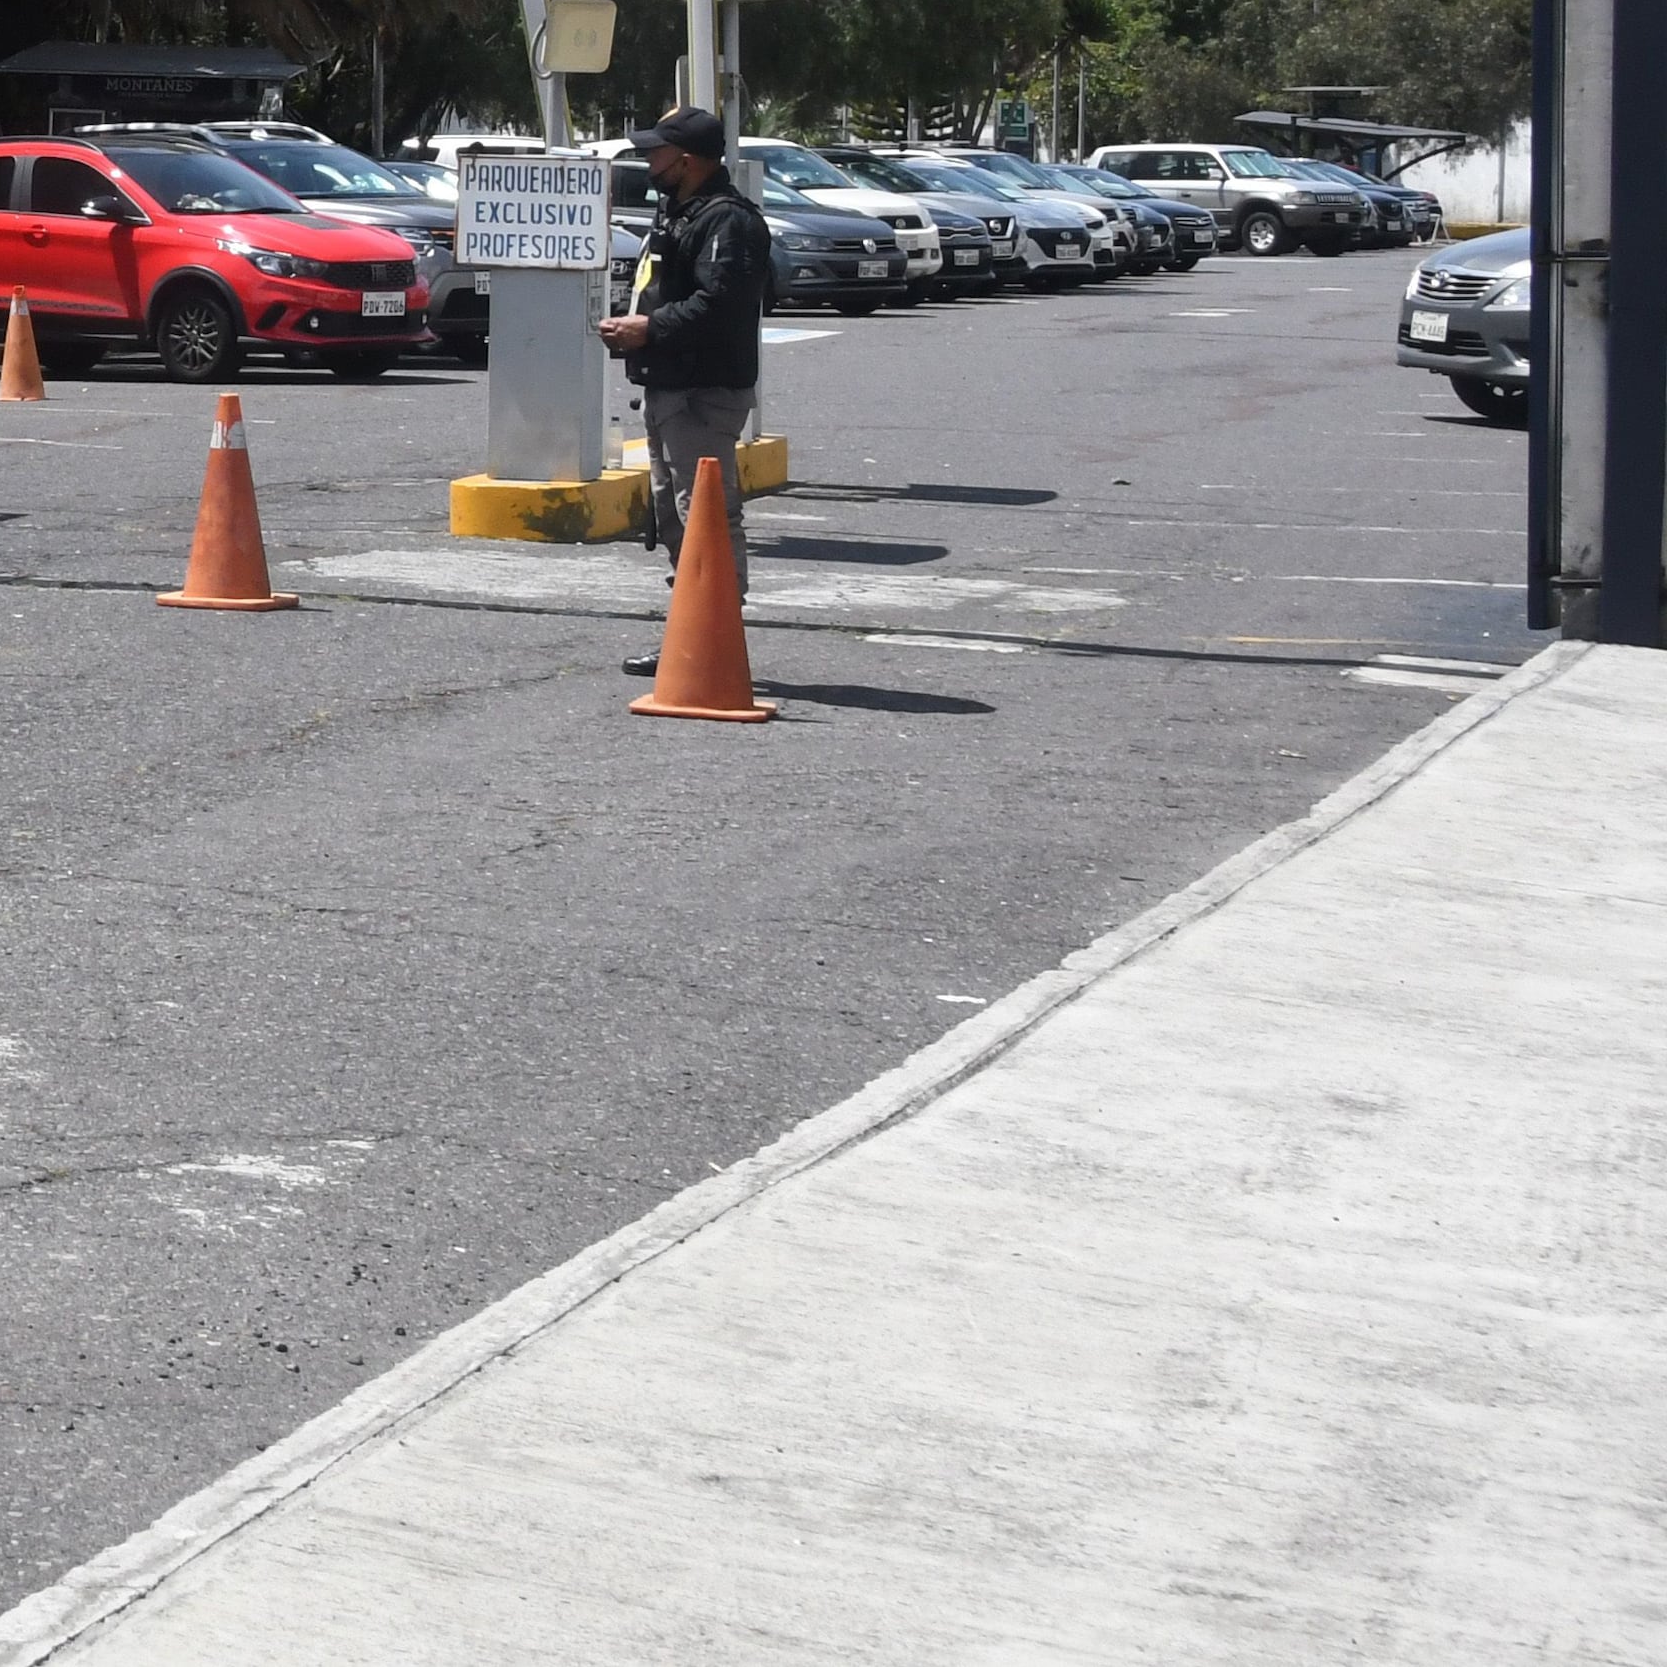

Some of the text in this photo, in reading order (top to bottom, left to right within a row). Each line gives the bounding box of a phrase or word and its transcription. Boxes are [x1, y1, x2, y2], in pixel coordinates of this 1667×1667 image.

[465, 164, 603, 195] PARQUEADERO
[475, 201, 593, 226] EXCLUSIVO
[466, 232, 596, 261] PROFESORES
